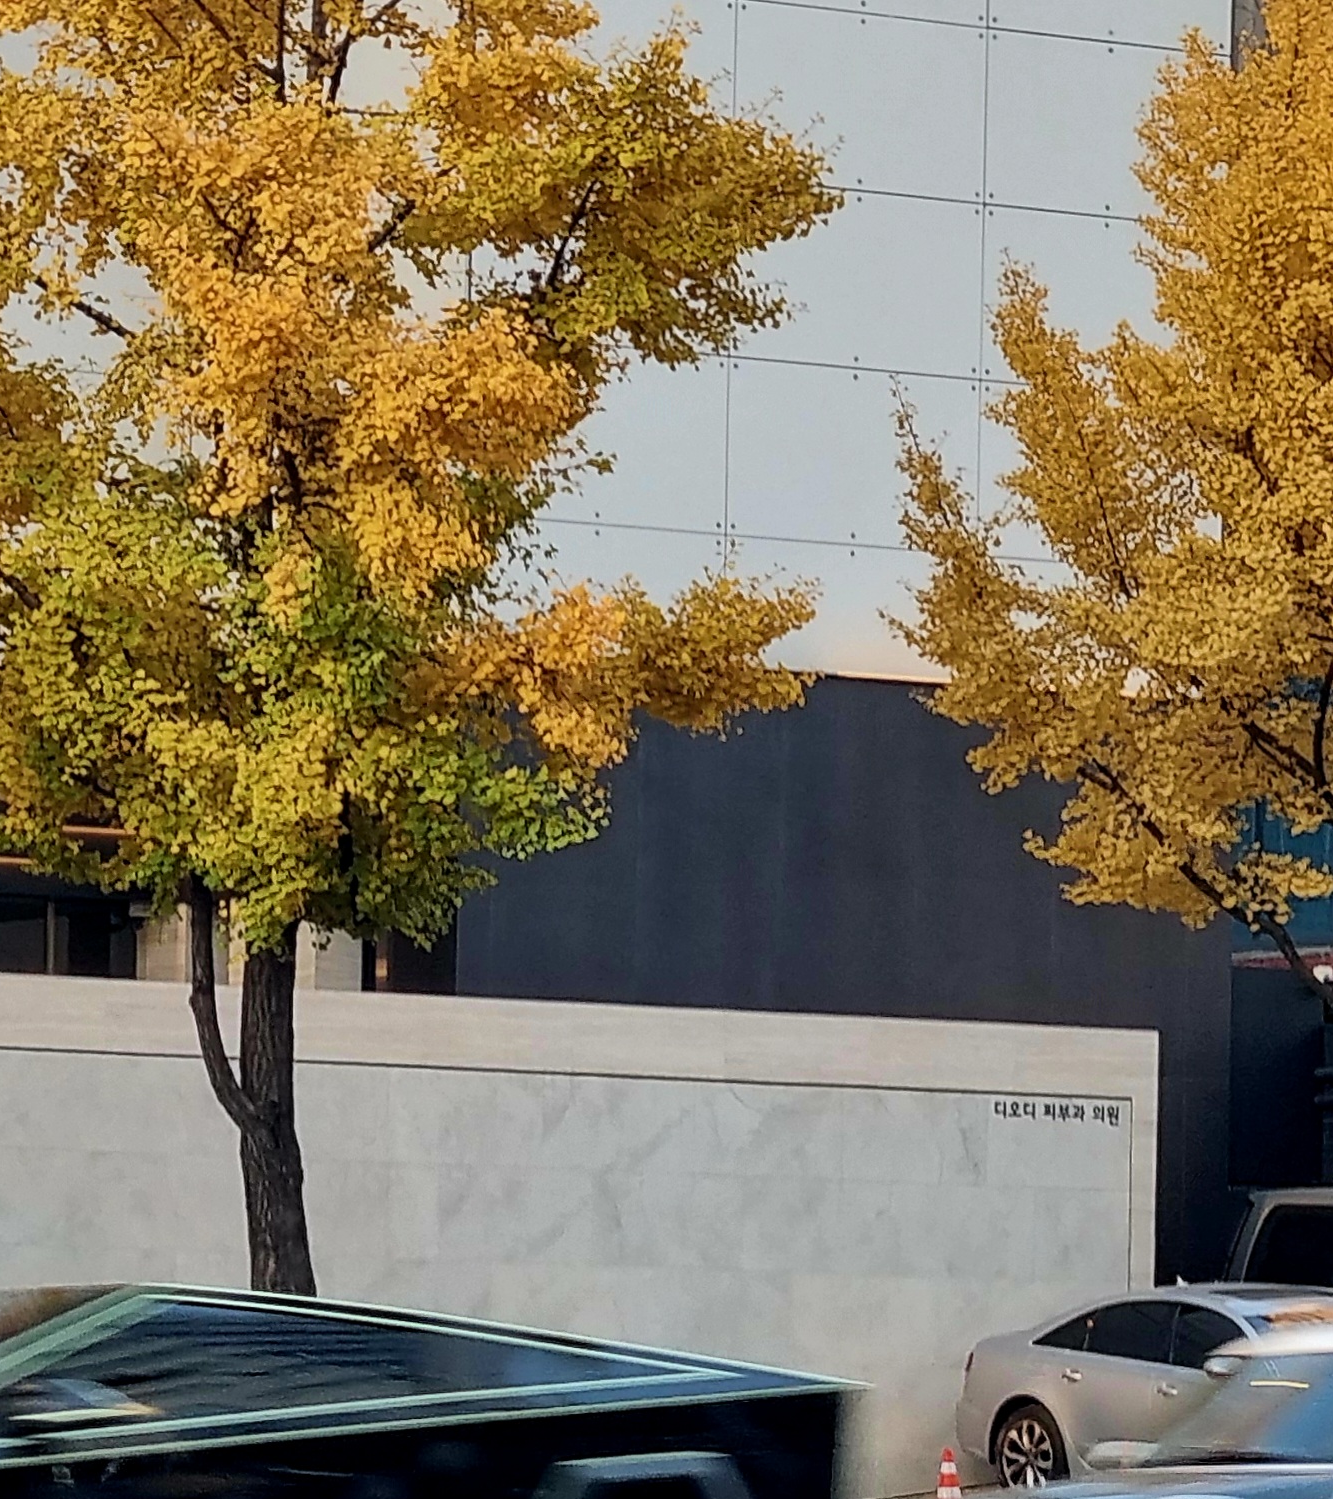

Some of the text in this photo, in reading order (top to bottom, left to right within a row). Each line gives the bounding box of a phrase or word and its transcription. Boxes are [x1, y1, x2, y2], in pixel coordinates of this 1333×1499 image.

[994, 1101, 1120, 1127] 디오디 피부과 의원
